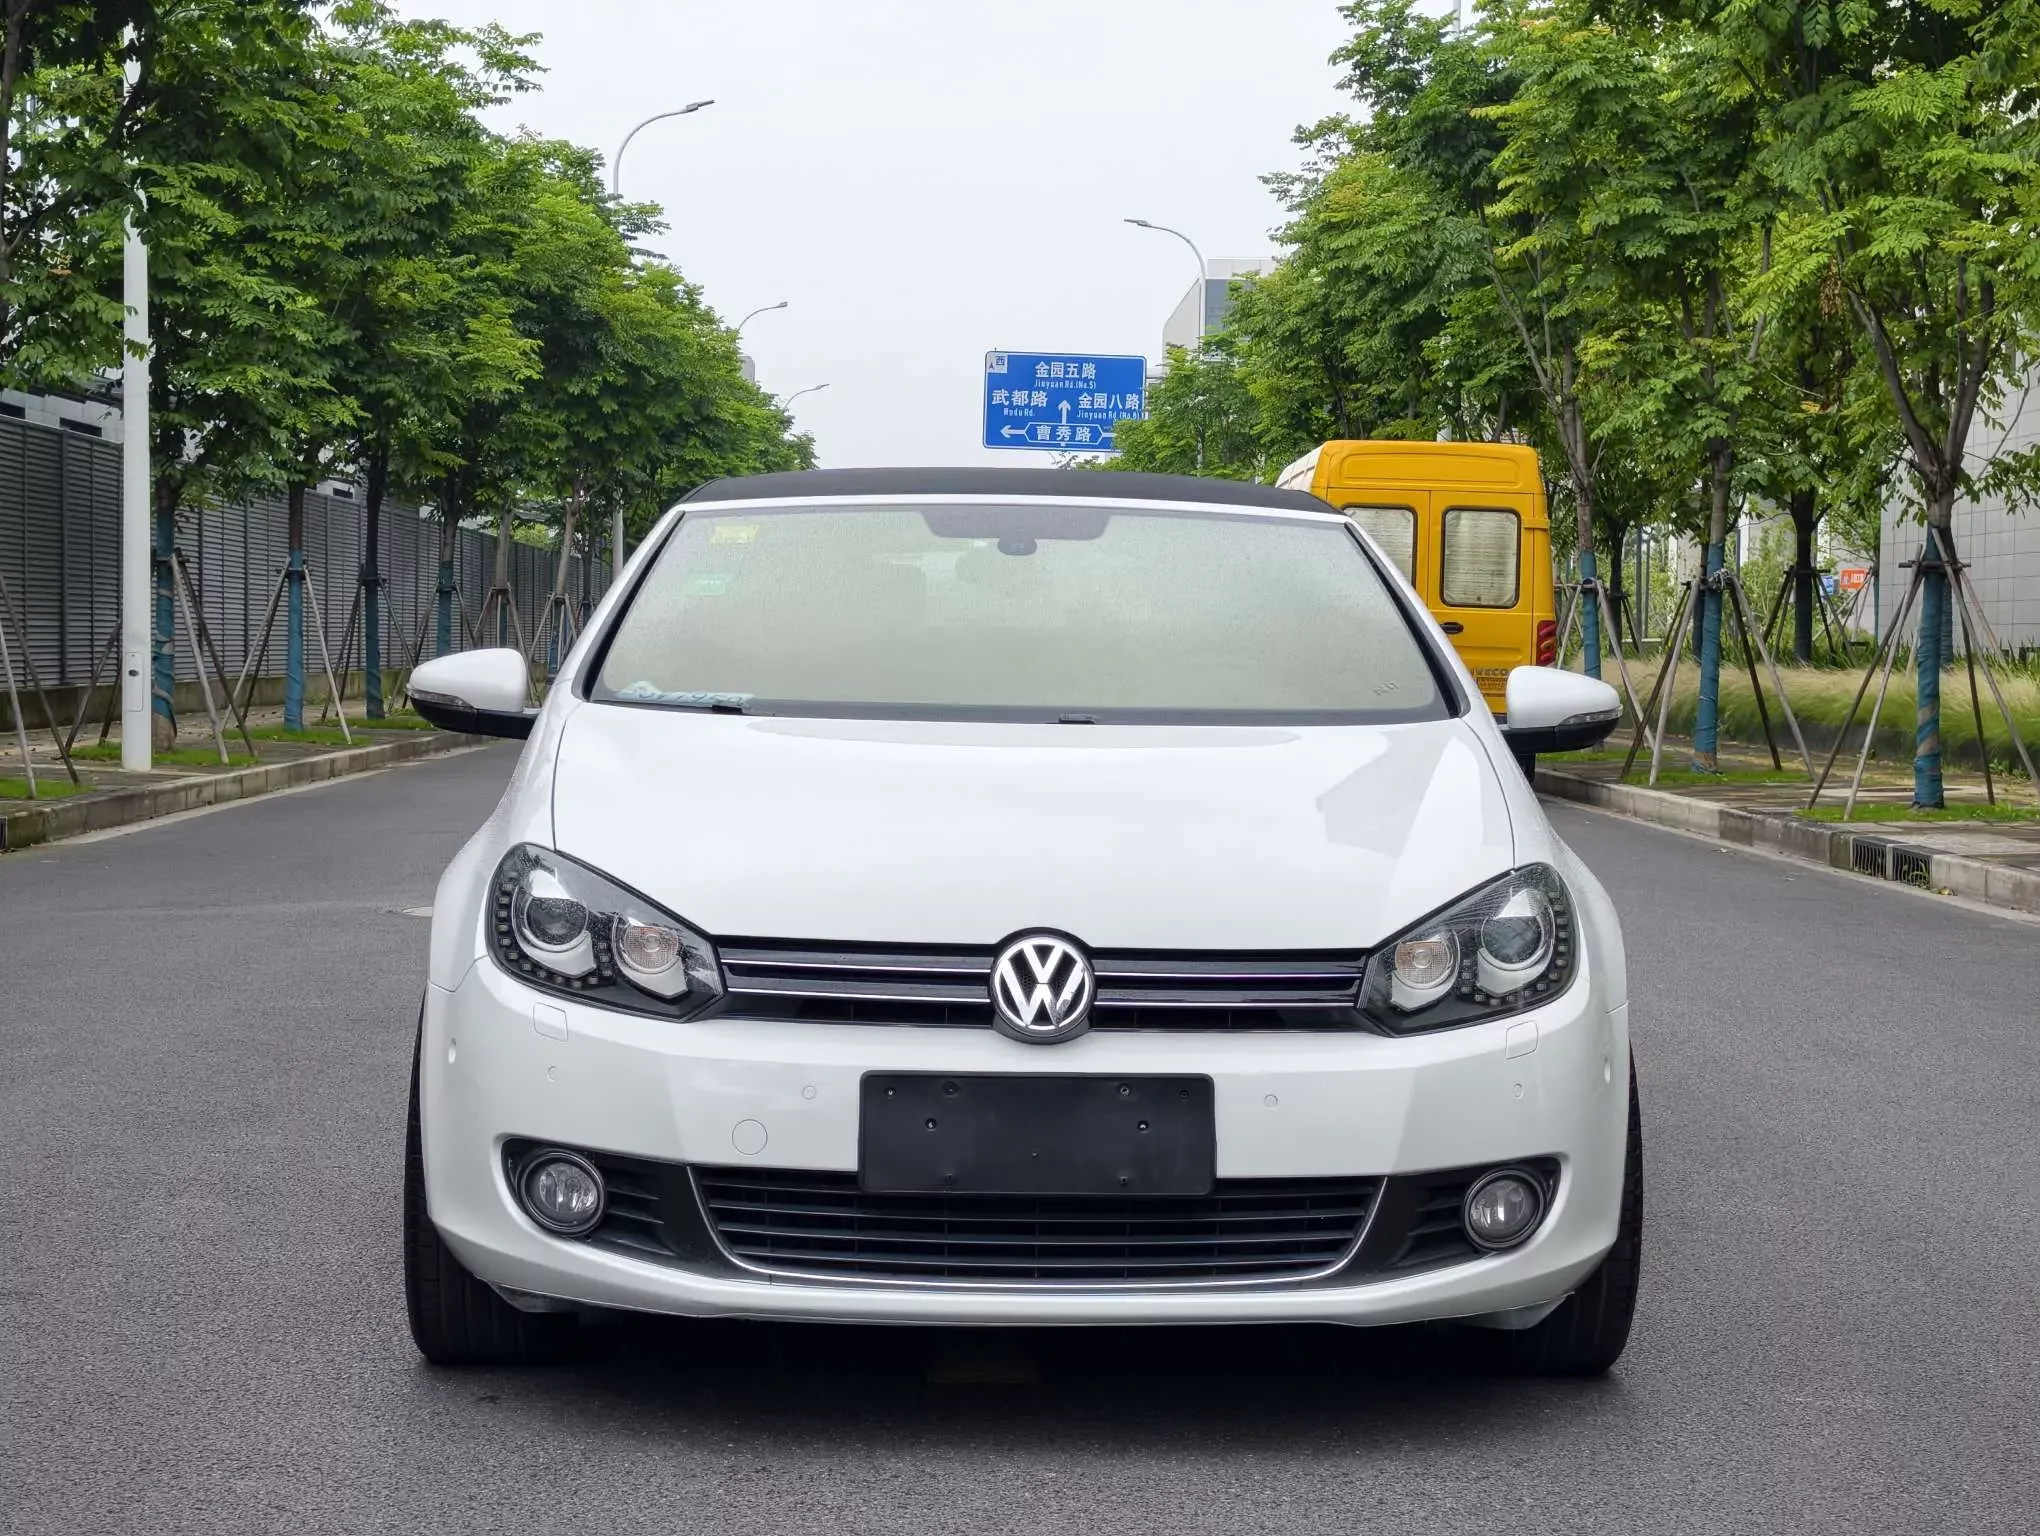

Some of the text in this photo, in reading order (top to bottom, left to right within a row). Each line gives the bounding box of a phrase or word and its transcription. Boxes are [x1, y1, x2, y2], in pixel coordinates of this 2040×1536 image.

[1035, 361, 1096, 379] 金园五路
[1034, 380, 1063, 389] Jinyuan
[991, 388, 1048, 407] 武都路
[1078, 392, 1140, 410] 金园八路
[1077, 410, 1107, 420] Jinyuan
[1036, 425, 1092, 443] 曹秀路
[996, 937, 1088, 1029] VW
